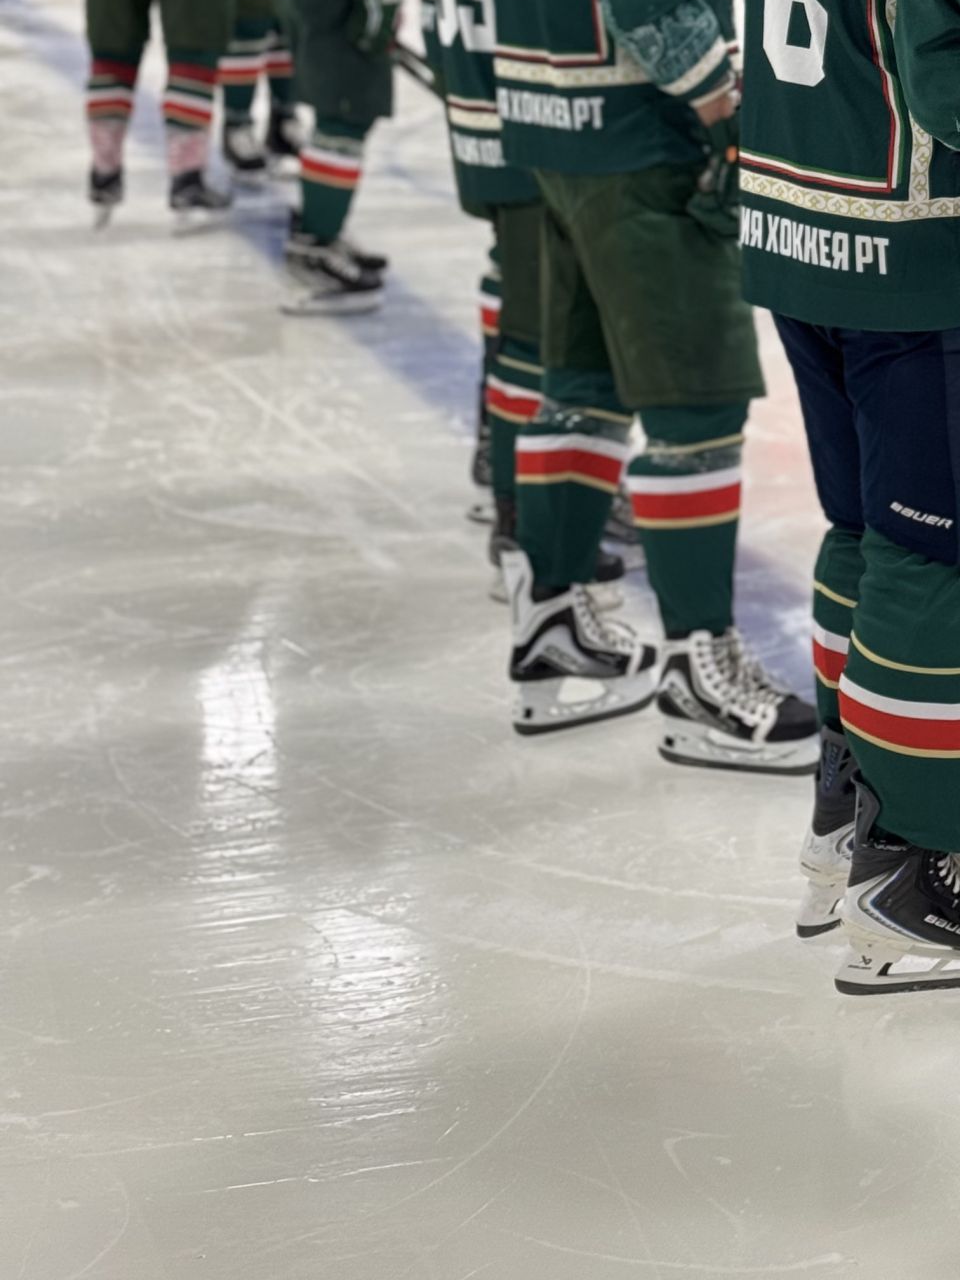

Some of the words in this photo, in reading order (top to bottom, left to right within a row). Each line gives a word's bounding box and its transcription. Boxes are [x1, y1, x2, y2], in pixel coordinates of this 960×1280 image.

[765, 213, 850, 271] ХОККЕЯ
[854, 234, 890, 276] РТ
[889, 501, 955, 530] BAUER
